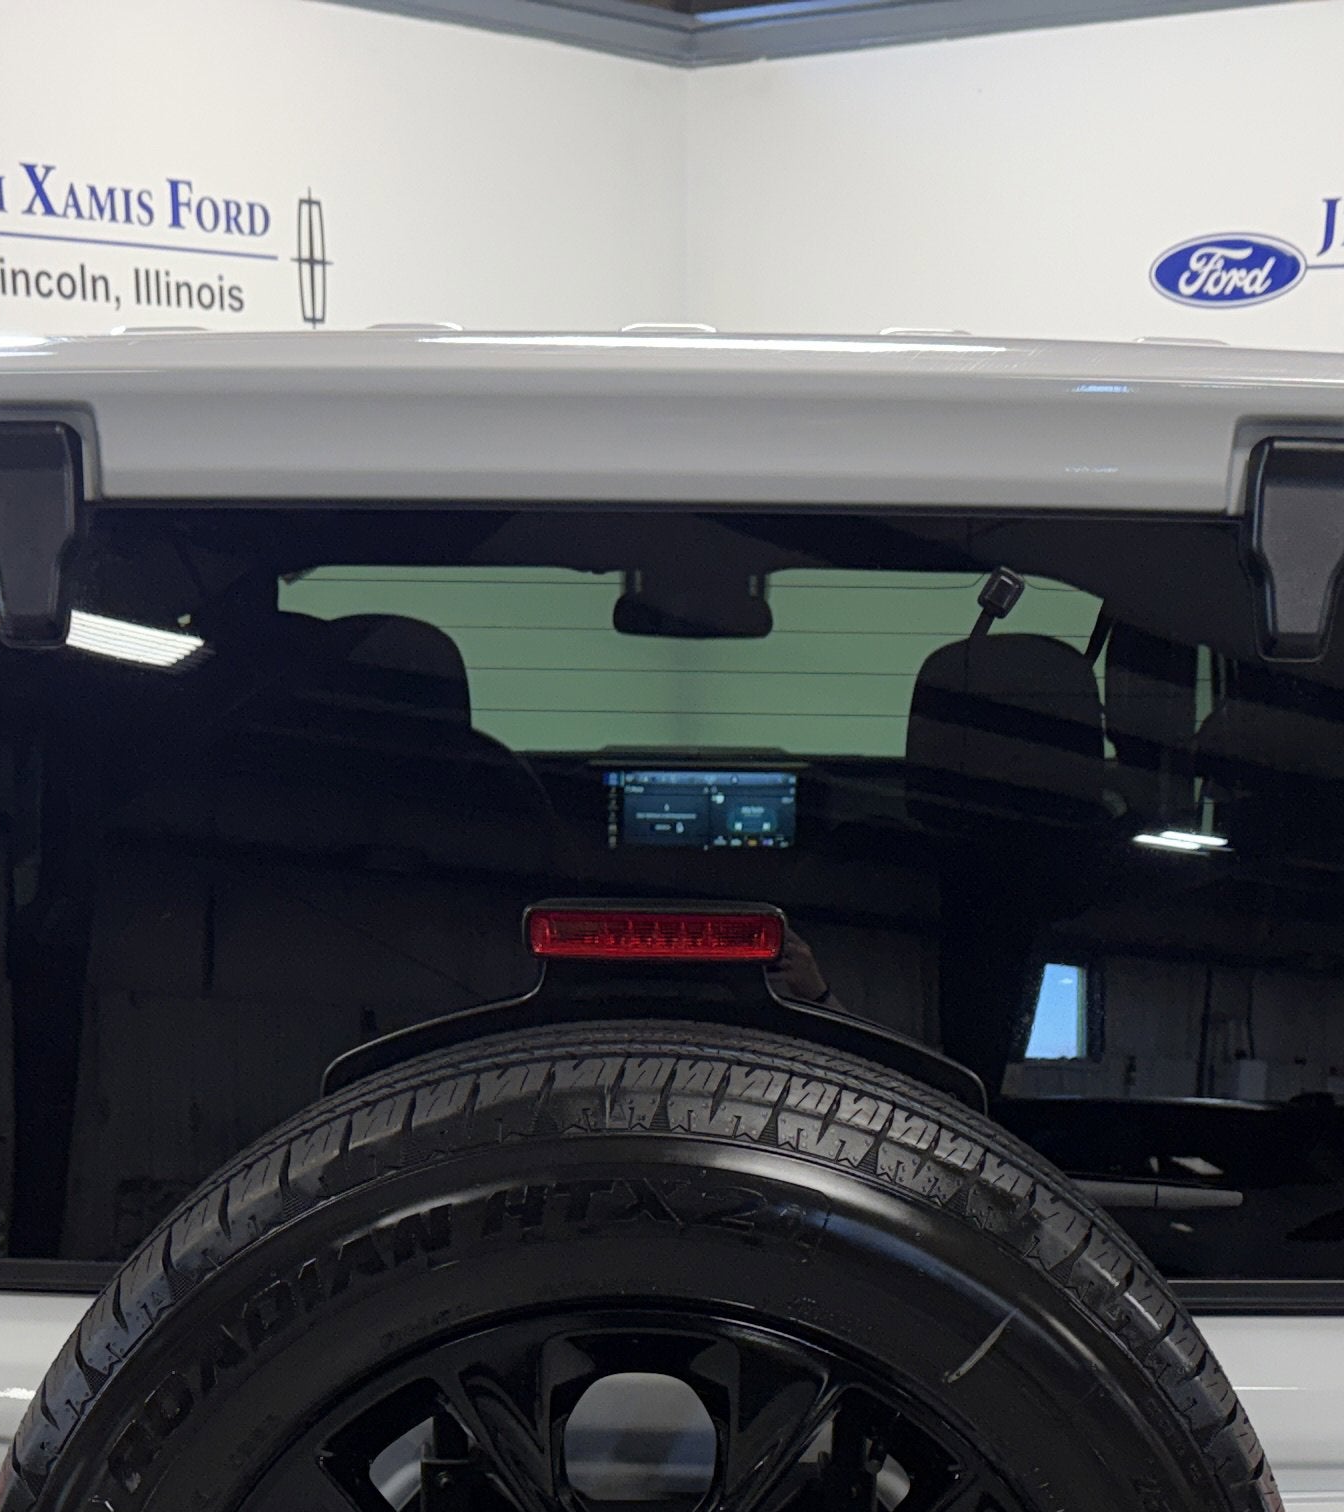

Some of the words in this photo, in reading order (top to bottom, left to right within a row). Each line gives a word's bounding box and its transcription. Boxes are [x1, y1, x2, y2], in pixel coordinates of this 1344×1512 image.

[19, 162, 154, 228] XAMIS
[166, 178, 270, 237] FORD
[134, 268, 246, 312] Illinois
[1177, 248, 1276, 296] Ford
